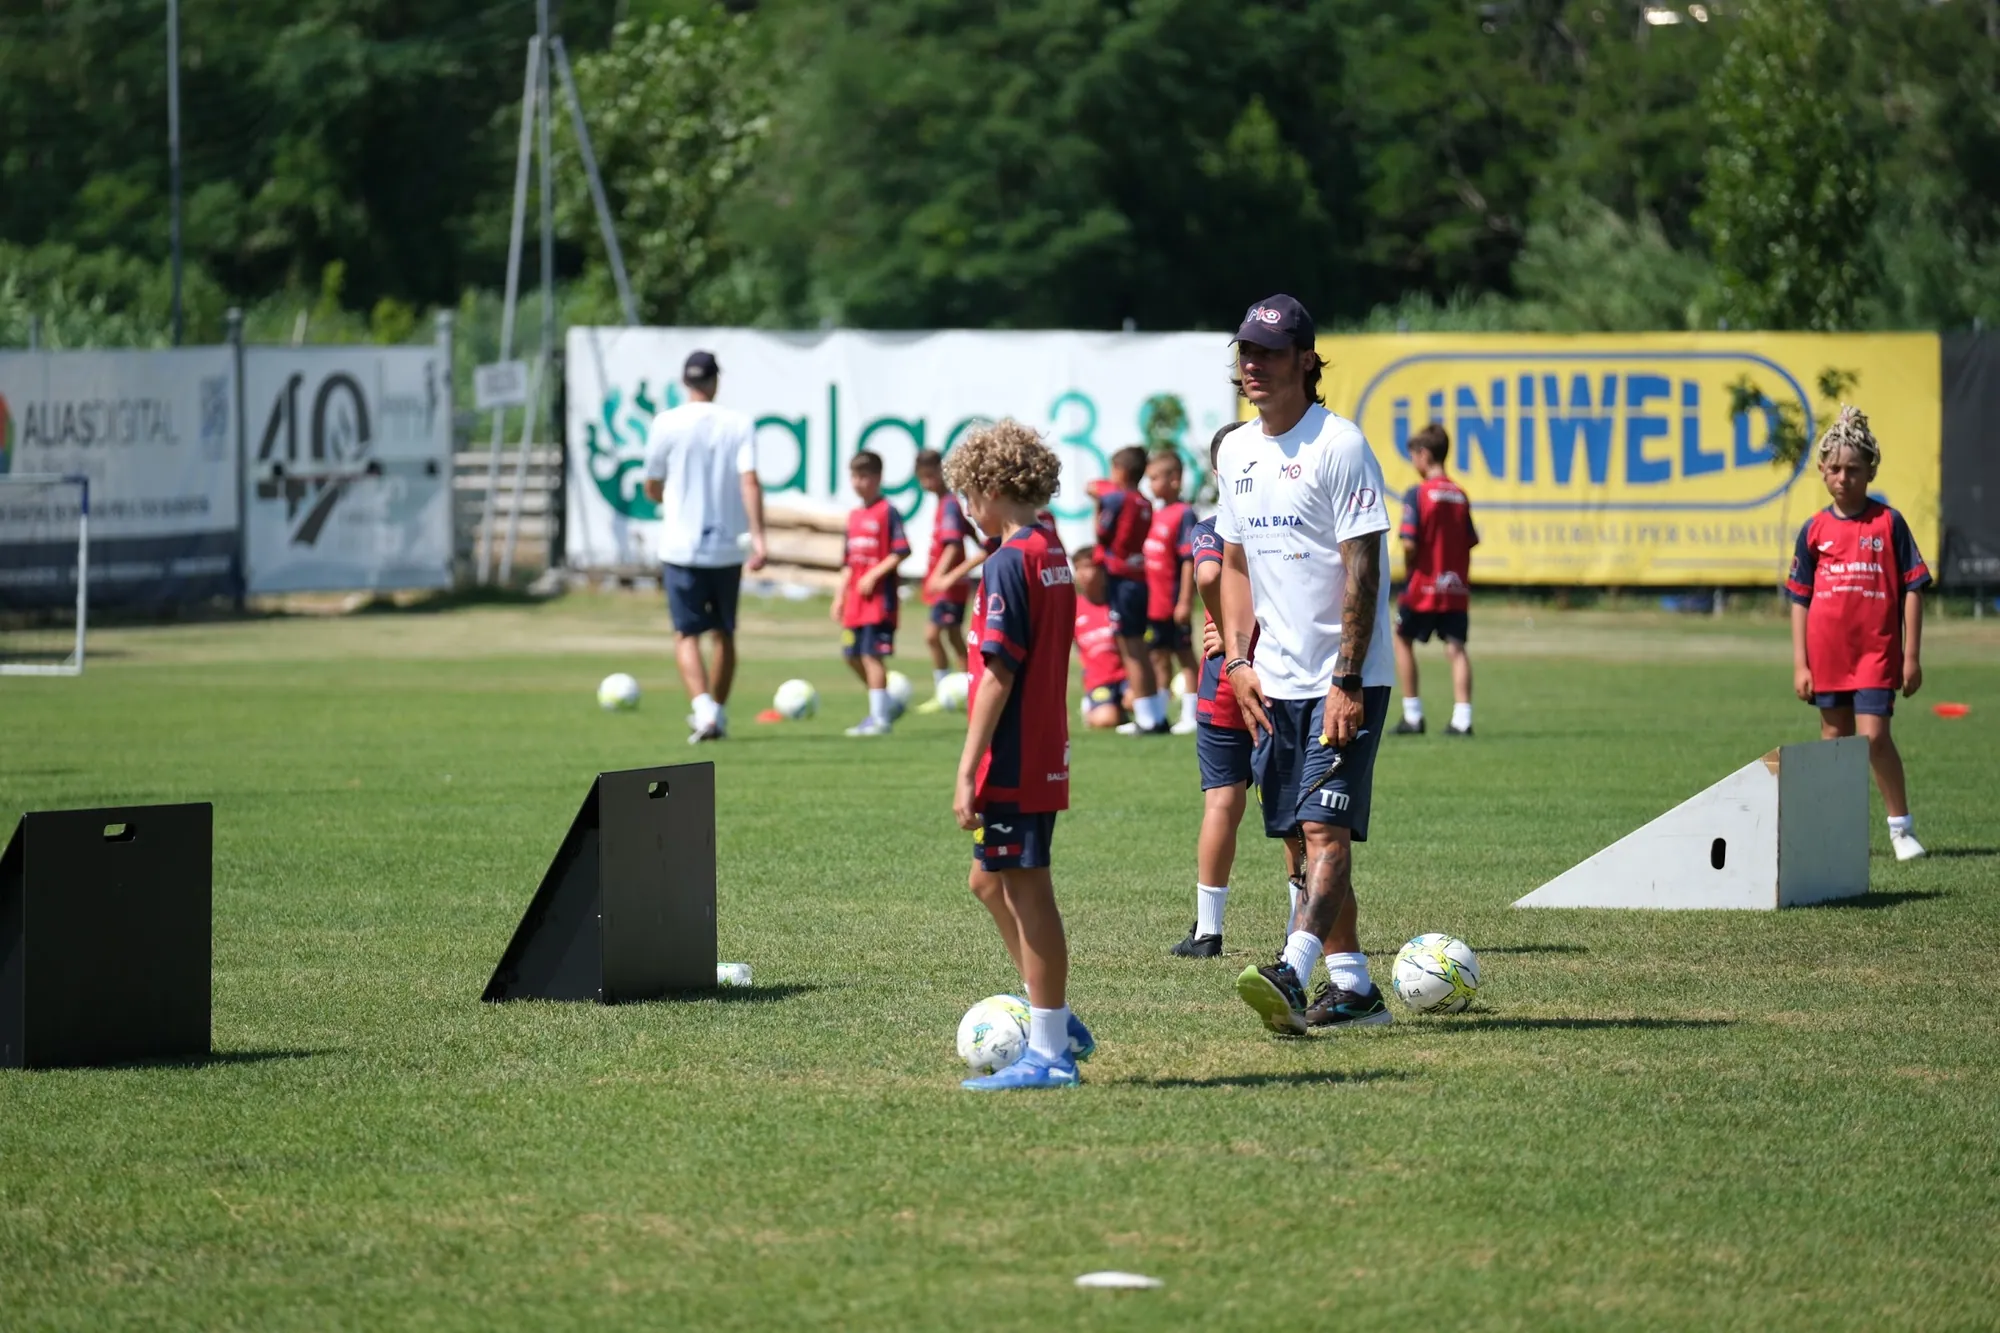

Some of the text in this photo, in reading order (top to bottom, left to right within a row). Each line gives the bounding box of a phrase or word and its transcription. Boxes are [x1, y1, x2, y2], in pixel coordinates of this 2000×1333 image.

[1391, 372, 1781, 486] UNIWELD
[1235, 477, 1253, 495] TM
[1248, 516, 1269, 528] VAL
[1320, 788, 1350, 811] TM
